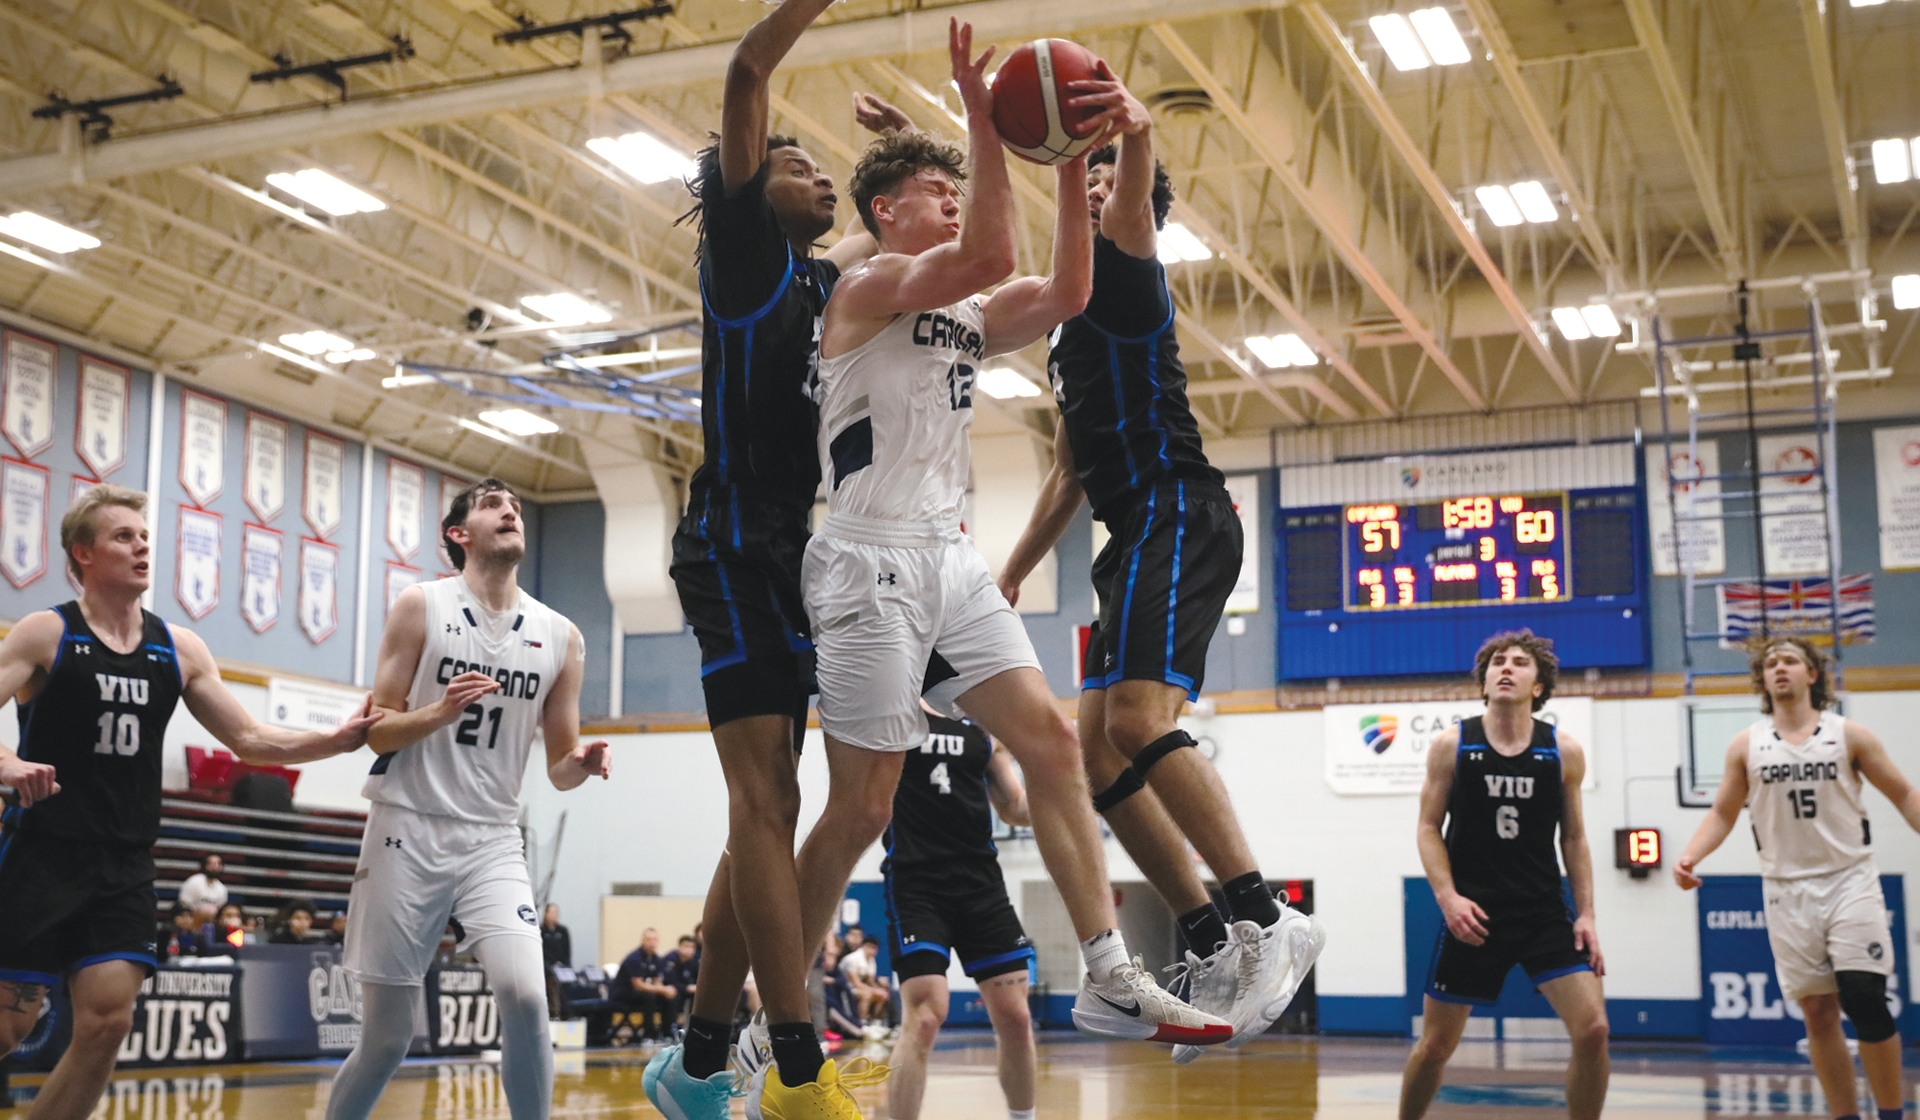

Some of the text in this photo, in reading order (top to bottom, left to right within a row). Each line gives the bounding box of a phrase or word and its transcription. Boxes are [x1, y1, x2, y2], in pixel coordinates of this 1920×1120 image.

[912, 313, 984, 361] CAPILA
[1443, 497, 1493, 529] 1:58
[1516, 510, 1555, 543] 60
[1362, 520, 1400, 552] 57
[1479, 536, 1495, 562] 3
[1370, 583, 1385, 609] 3
[1398, 582, 1413, 607] 3
[1501, 577, 1515, 602] 3
[1541, 574, 1558, 600] 5
[95, 672, 150, 706] VIU
[94, 711, 140, 757] 10
[456, 703, 504, 749] 21
[920, 733, 964, 755] VIU
[929, 762, 952, 794] 4
[1484, 774, 1535, 799] VIU
[1761, 762, 1837, 784] CAPILANO
[1787, 789, 1817, 819] 15
[1495, 805, 1519, 839] 6
[1629, 830, 1659, 863] 13
[1707, 911, 1768, 929] CAPILA
[156, 970, 233, 997] UNIVERSITY
[117, 1000, 231, 1062] LUES
[438, 995, 503, 1047] BLU
